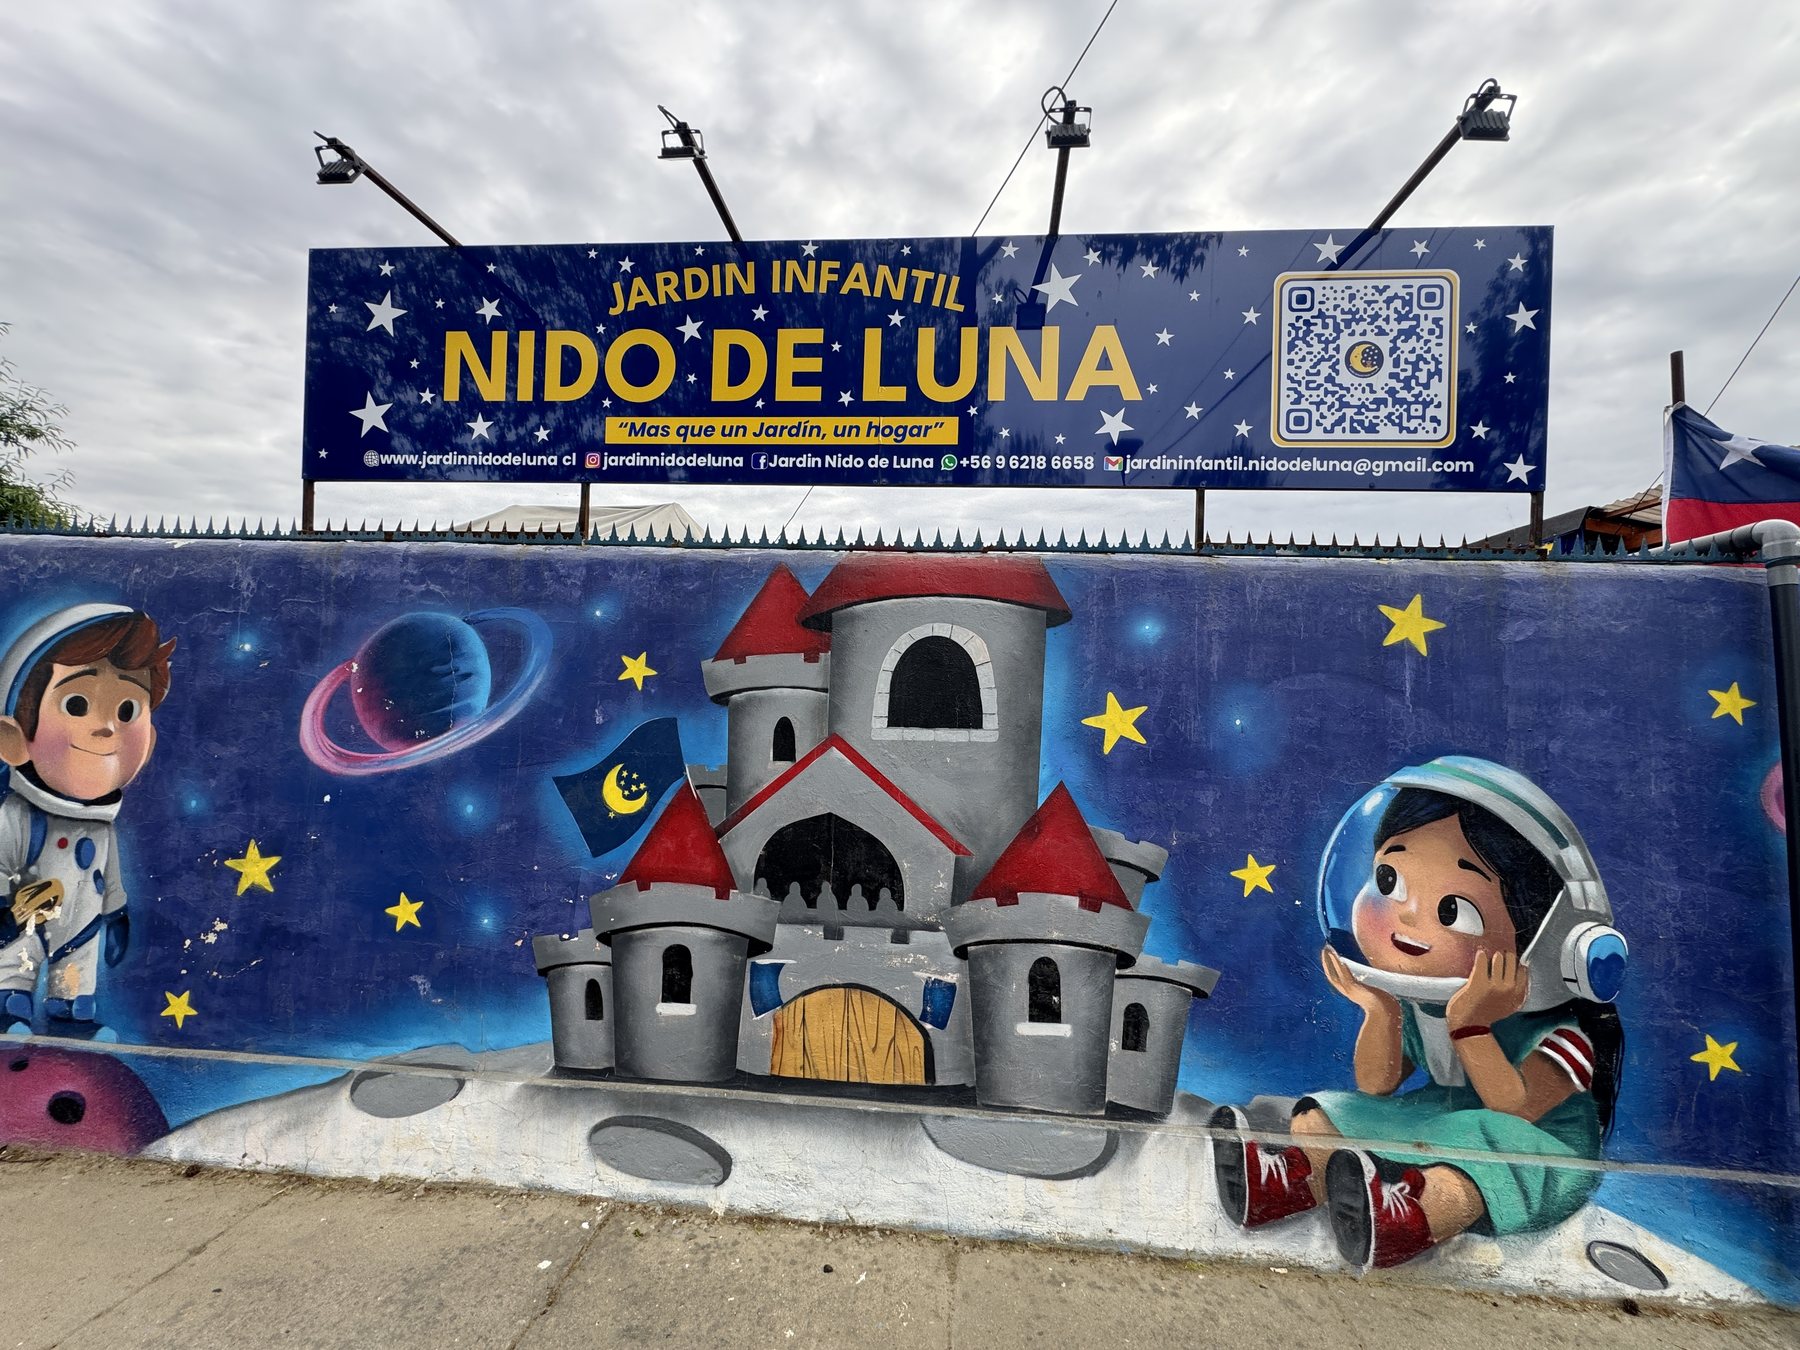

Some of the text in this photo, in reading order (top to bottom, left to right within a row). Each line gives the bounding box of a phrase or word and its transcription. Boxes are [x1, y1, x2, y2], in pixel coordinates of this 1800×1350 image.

[608, 260, 965, 316] JARDIN INFANTIL
[443, 325, 1143, 403] NIDO DE LUNA
[676, 425, 715, 442] que
[720, 426, 748, 438] un
[752, 420, 827, 439] Jardín,
[833, 425, 861, 438] un
[602, 452, 744, 470] jardinnidodeluna
[769, 453, 934, 469] Jardin Nido de Luna
[960, 456, 1095, 470] +56 9 6218 6658
[1125, 455, 1475, 475] jardininfantil.nidodeluna@gmail.com
